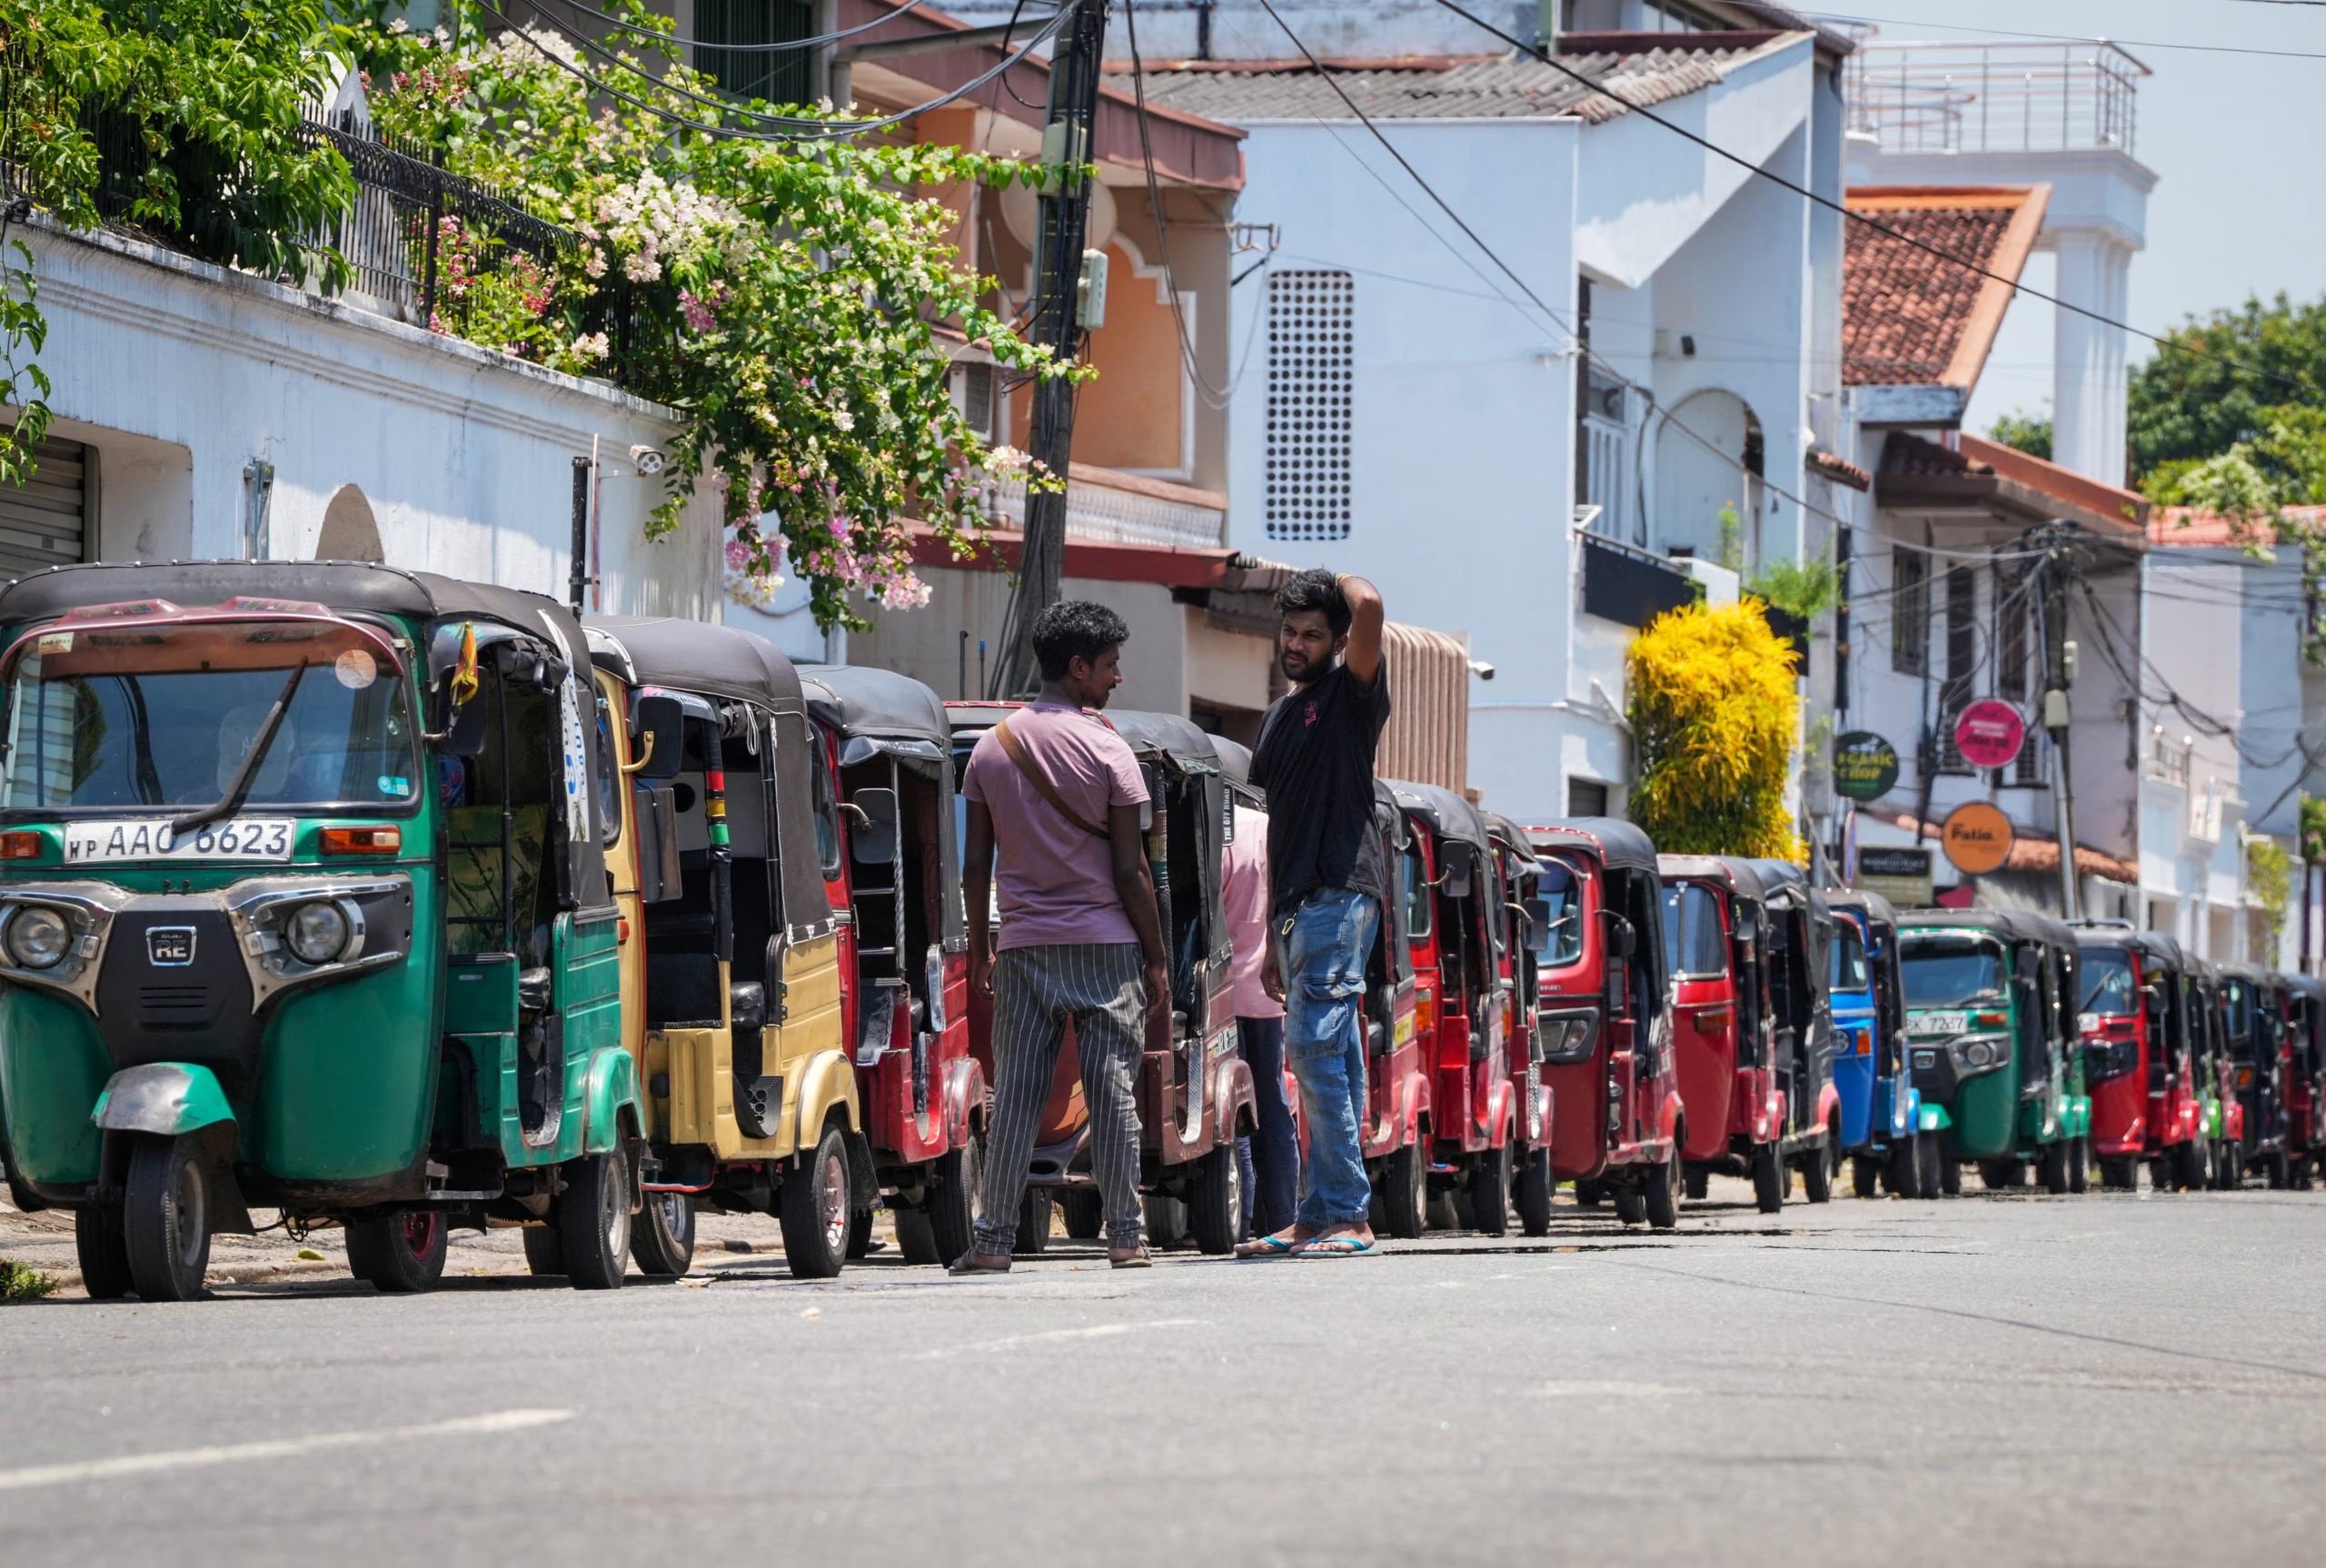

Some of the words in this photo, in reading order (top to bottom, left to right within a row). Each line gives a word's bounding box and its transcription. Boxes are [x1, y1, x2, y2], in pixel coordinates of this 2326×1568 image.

[1222, 811, 1231, 826] OFF
[69, 839, 98, 858] WP
[105, 823, 177, 856] AAO
[195, 823, 289, 855] 6623
[1223, 826, 1232, 841] THE
[155, 939, 187, 958] RE
